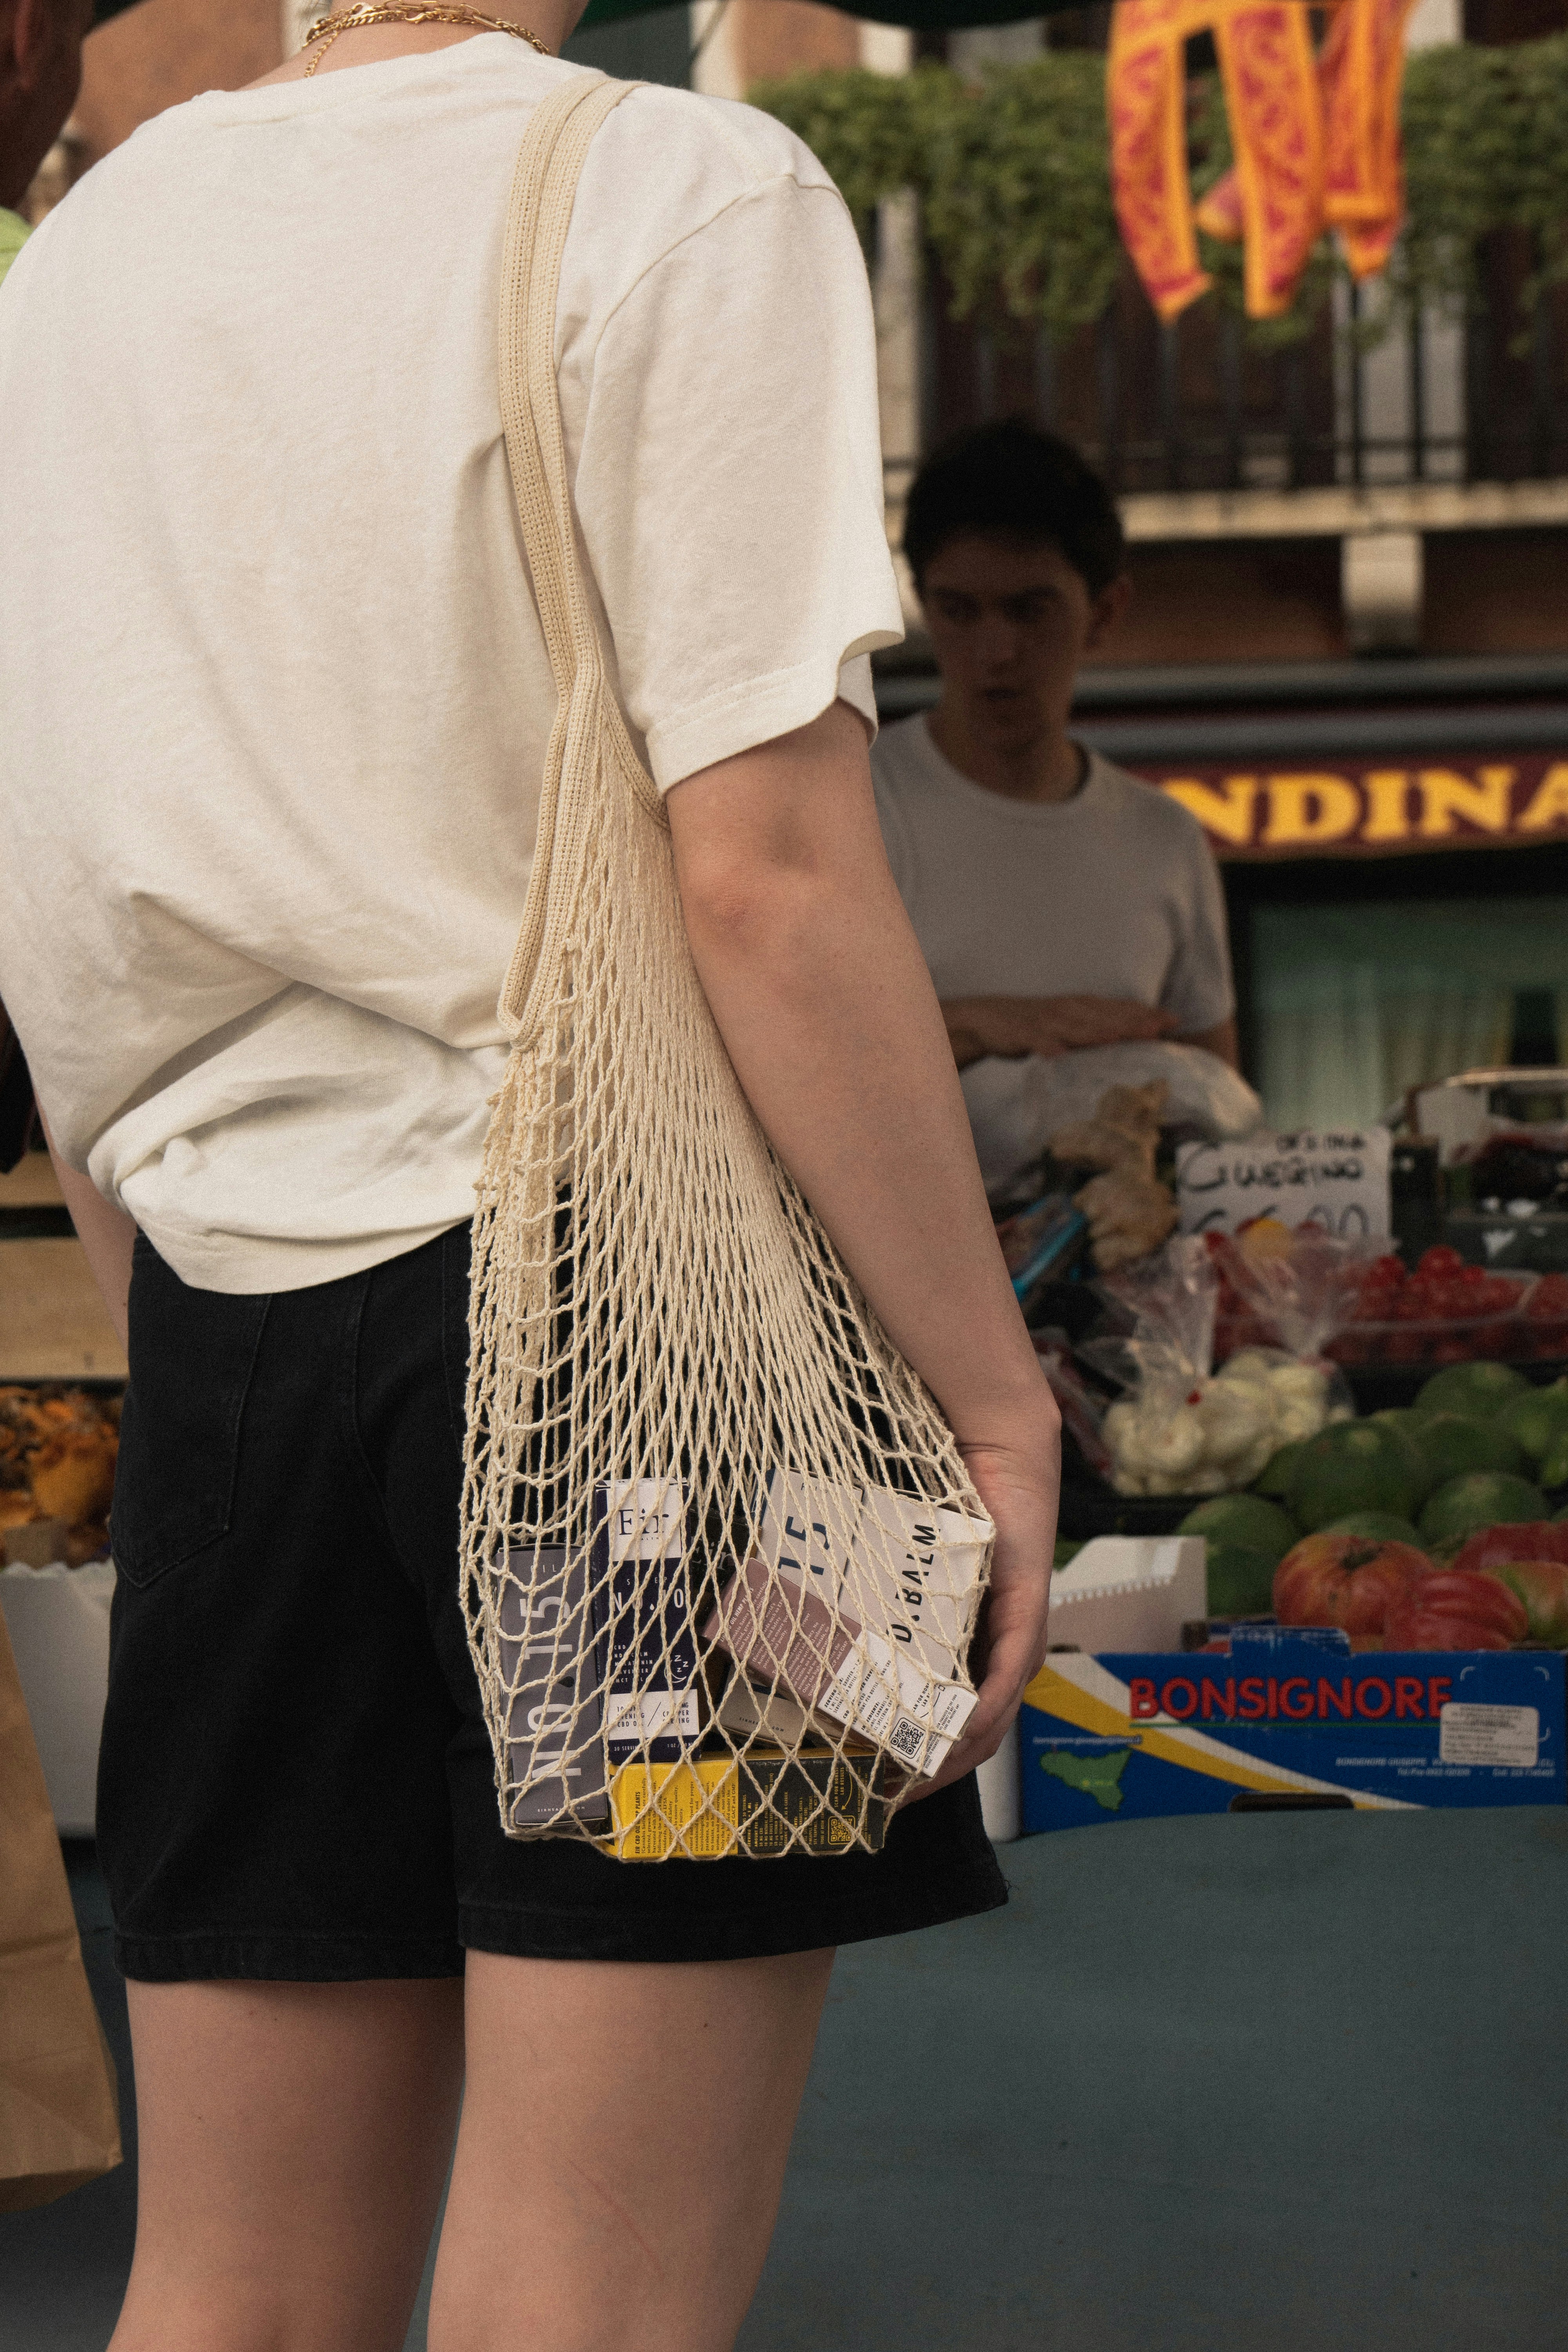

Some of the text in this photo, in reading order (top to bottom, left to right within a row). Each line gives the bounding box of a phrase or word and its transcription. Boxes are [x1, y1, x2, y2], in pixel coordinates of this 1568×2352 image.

[739, 1612, 750, 1626] Sativa
[754, 1579, 769, 1600] carefully
[764, 1602, 776, 1618] world's
[729, 1602, 745, 1625] OIL HEMP
[768, 1612, 777, 1623] such
[770, 1616, 782, 1631] Safety
[773, 1622, 784, 1637] ensure
[812, 1621, 826, 1639] colours,
[777, 1628, 788, 1644] purity.
[737, 1641, 746, 1653] hand
[792, 1641, 800, 1652] ratio
[795, 1665, 807, 1681] toxins,
[815, 1632, 827, 1648] metals,
[797, 1674, 808, 1690] aromas
[842, 1670, 854, 1687] DROPPER
[801, 1682, 811, 1694] Only
[824, 1688, 837, 1708] SERVING
[1129, 1675, 1453, 1719] BONSIGNORE
[875, 1699, 887, 1718] CANNABIS
[876, 1707, 889, 1726] SPECTRUM
